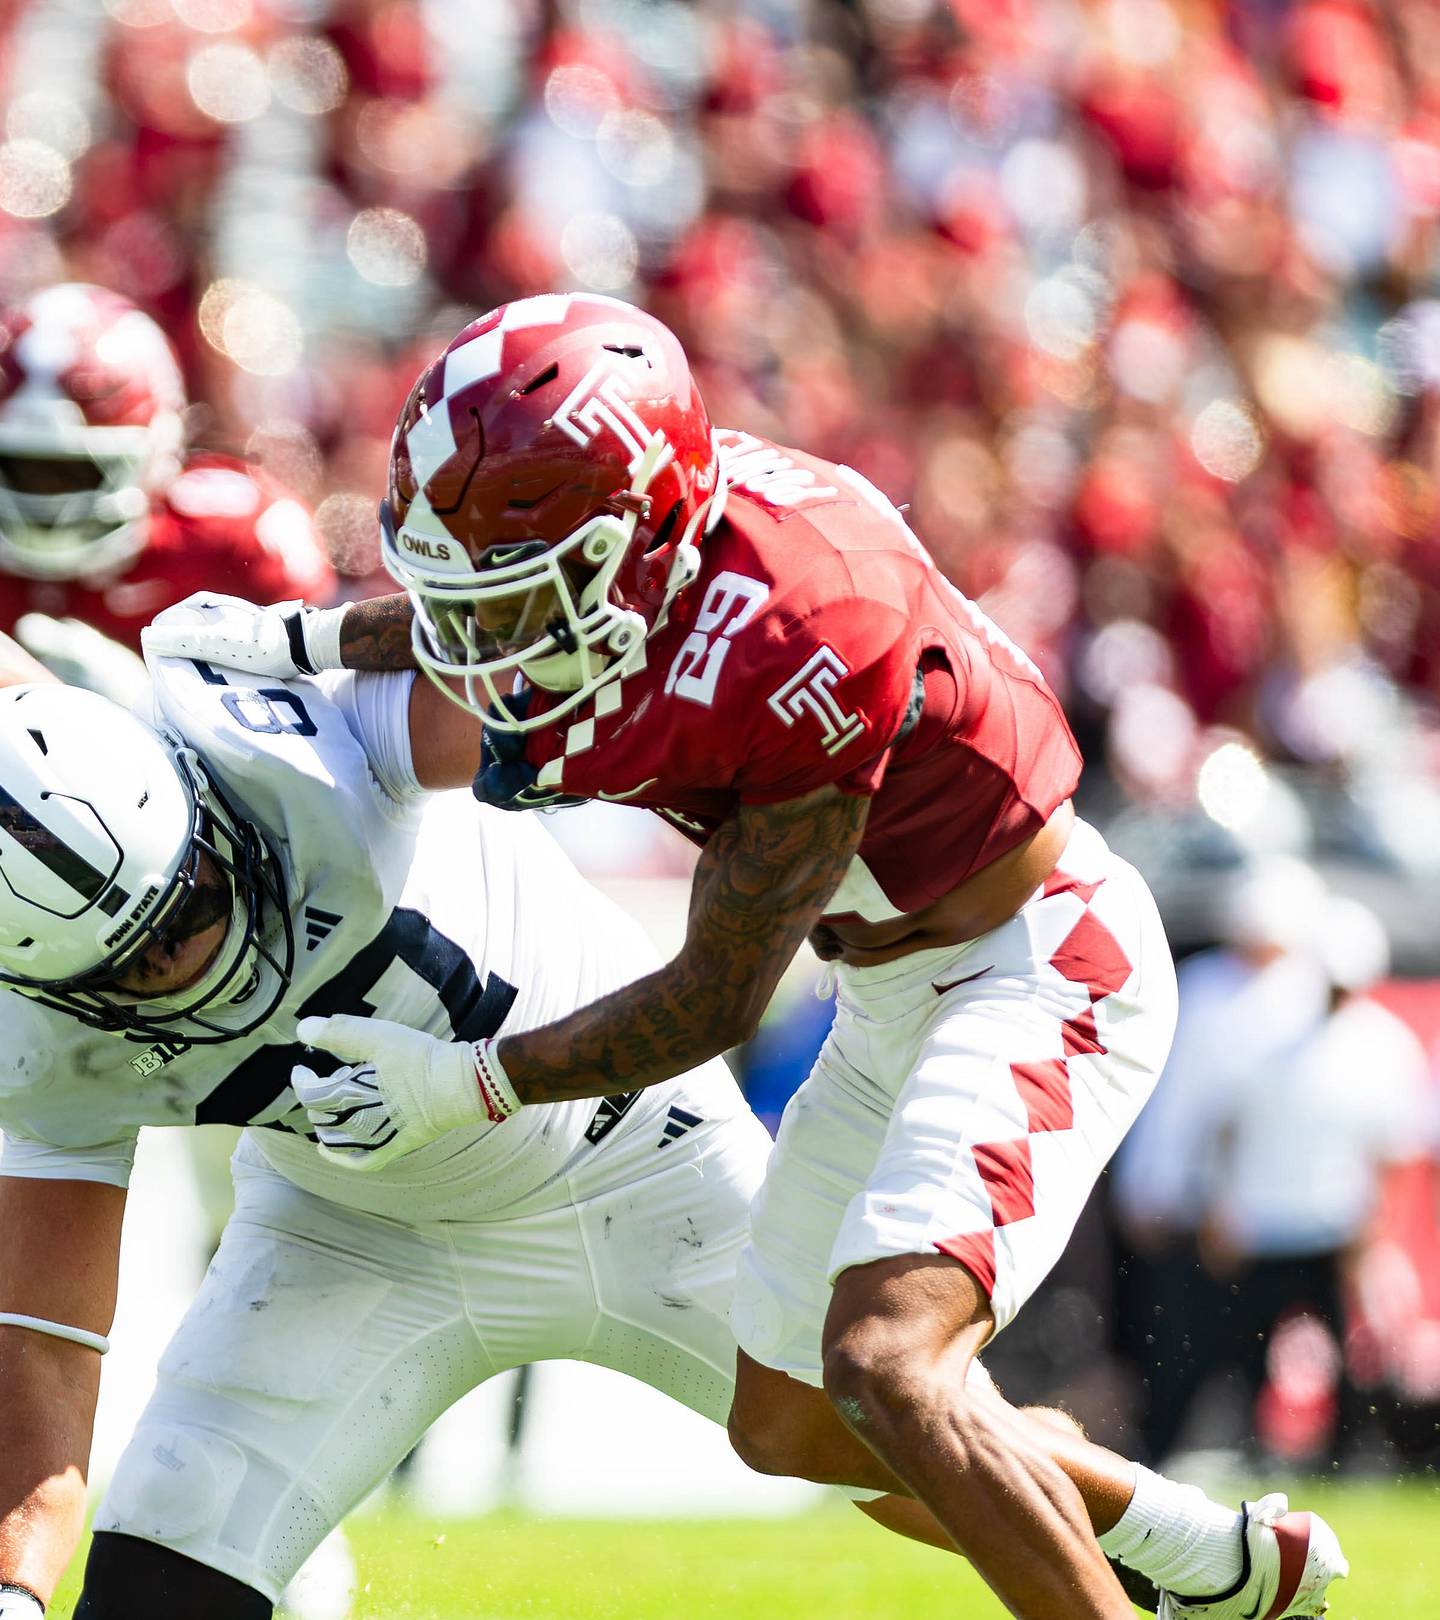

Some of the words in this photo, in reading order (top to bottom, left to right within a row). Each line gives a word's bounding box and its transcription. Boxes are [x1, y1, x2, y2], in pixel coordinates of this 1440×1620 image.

[402, 534, 450, 561] OWLS
[664, 570, 769, 706] 29
[767, 644, 865, 757] T
[104, 919, 134, 948] PENN
[130, 885, 159, 921] STATE
